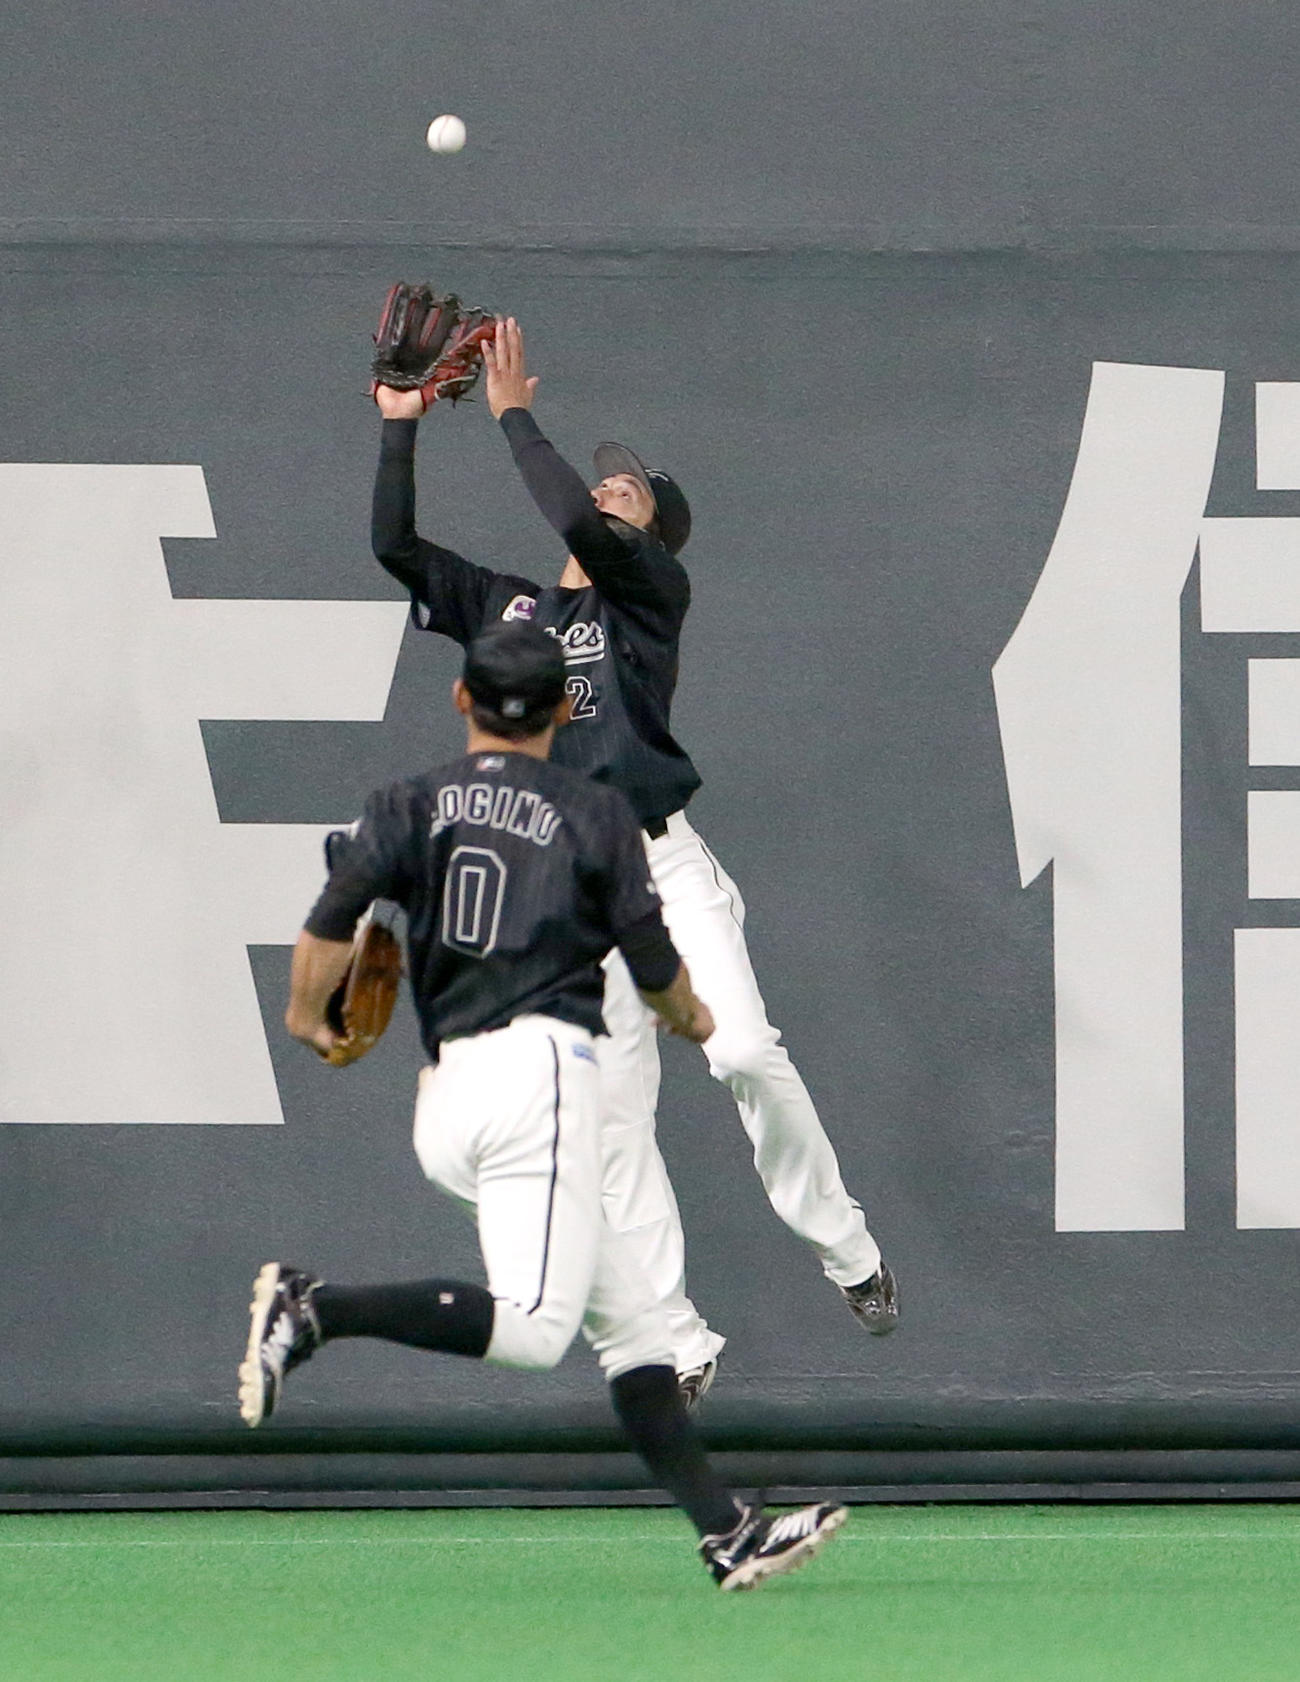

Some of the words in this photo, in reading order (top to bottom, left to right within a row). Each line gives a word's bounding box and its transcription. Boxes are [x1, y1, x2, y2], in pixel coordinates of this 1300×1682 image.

[564, 676, 598, 721] 2
[432, 782, 562, 847] OGINO
[442, 845, 508, 960] 0
